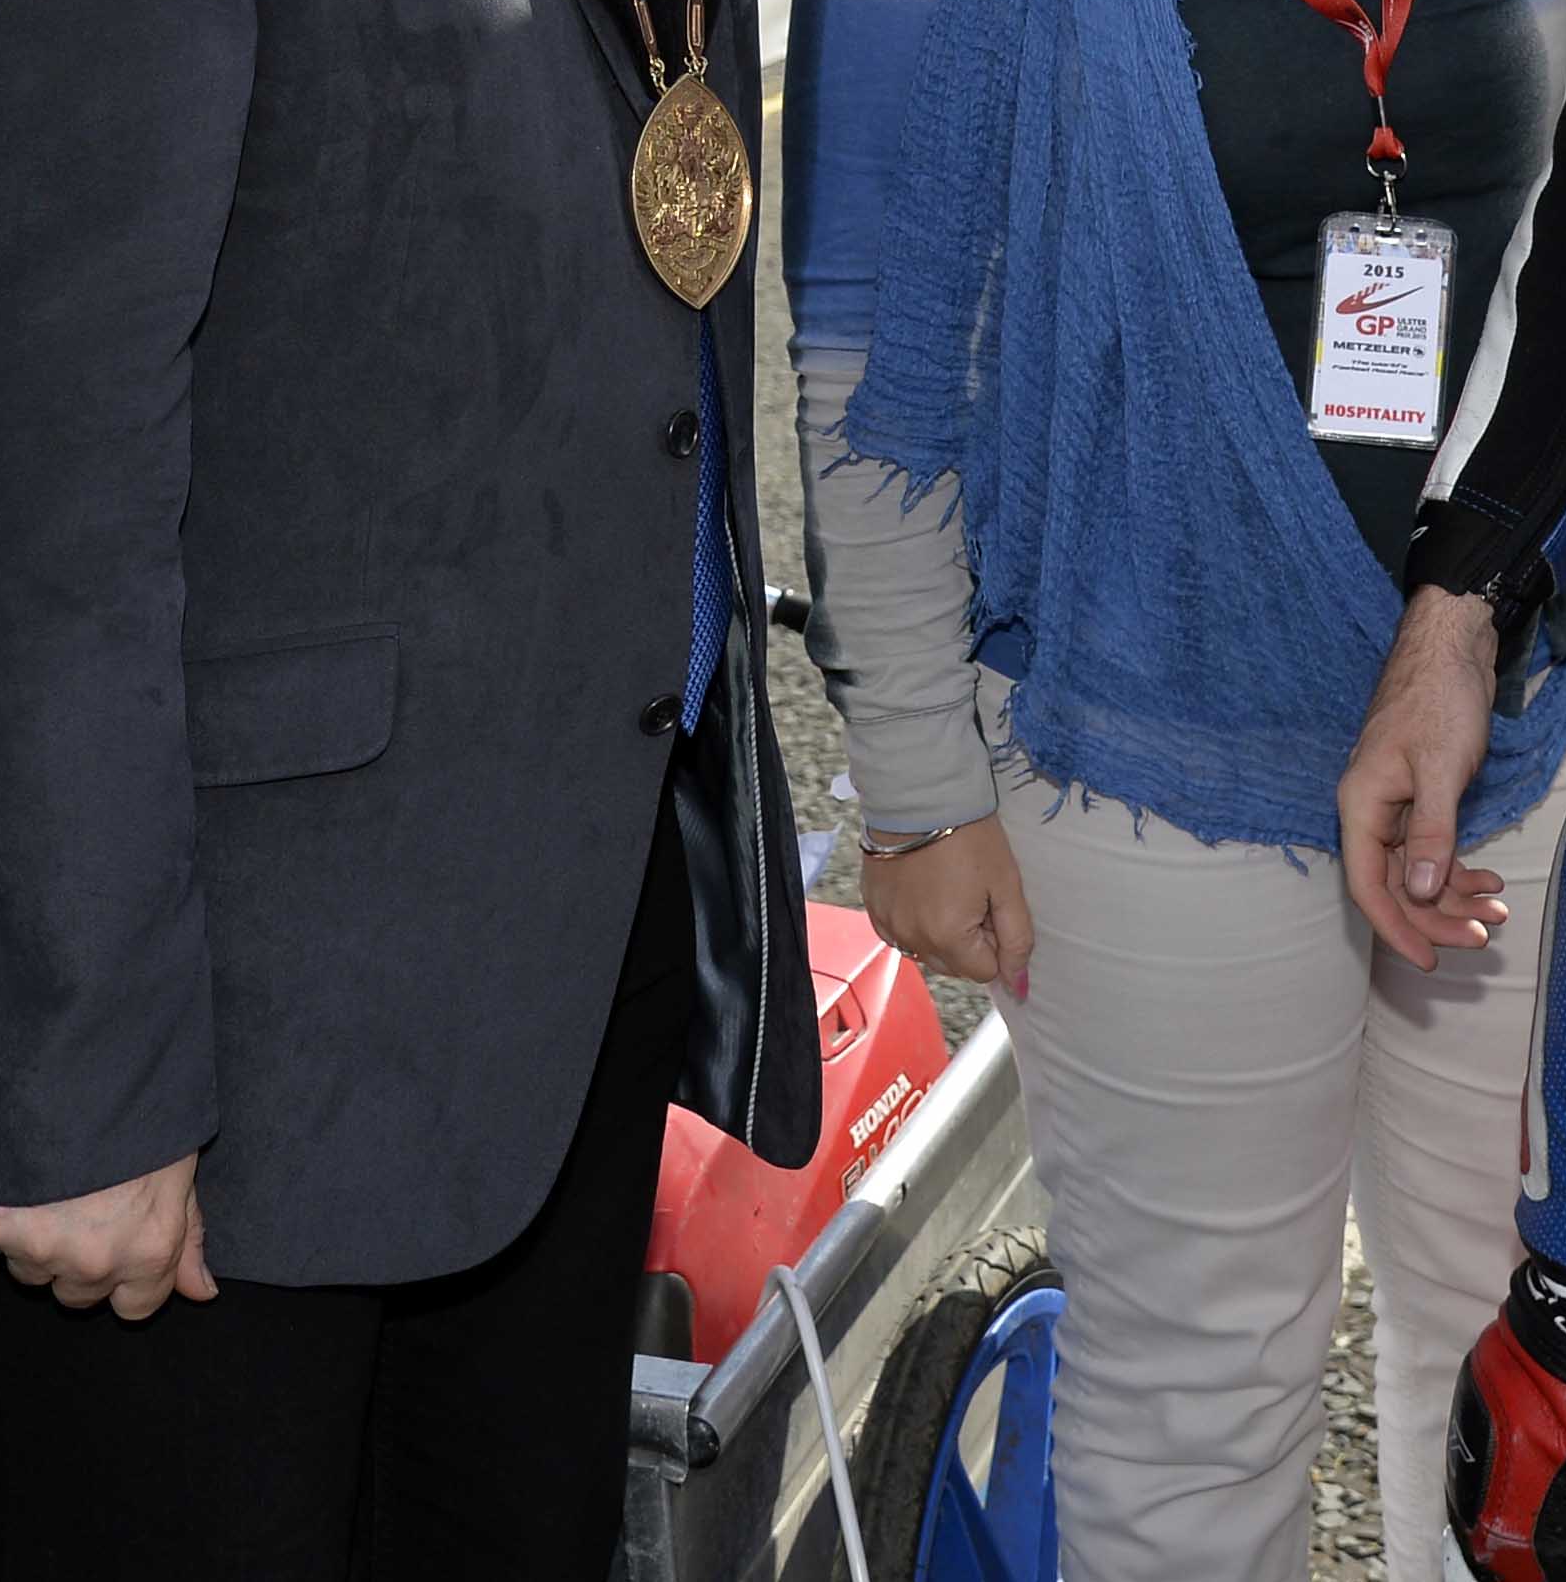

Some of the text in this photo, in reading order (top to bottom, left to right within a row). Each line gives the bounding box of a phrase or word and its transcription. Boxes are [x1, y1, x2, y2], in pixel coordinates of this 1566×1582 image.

[1363, 263, 1405, 279] 2015
[1356, 314, 1395, 337] GP
[1396, 316, 1427, 326] ULSTER
[1332, 340, 1412, 356] METZELER
[1324, 403, 1426, 424] HOSPITALITY
[849, 1073, 913, 1149] HONDA
